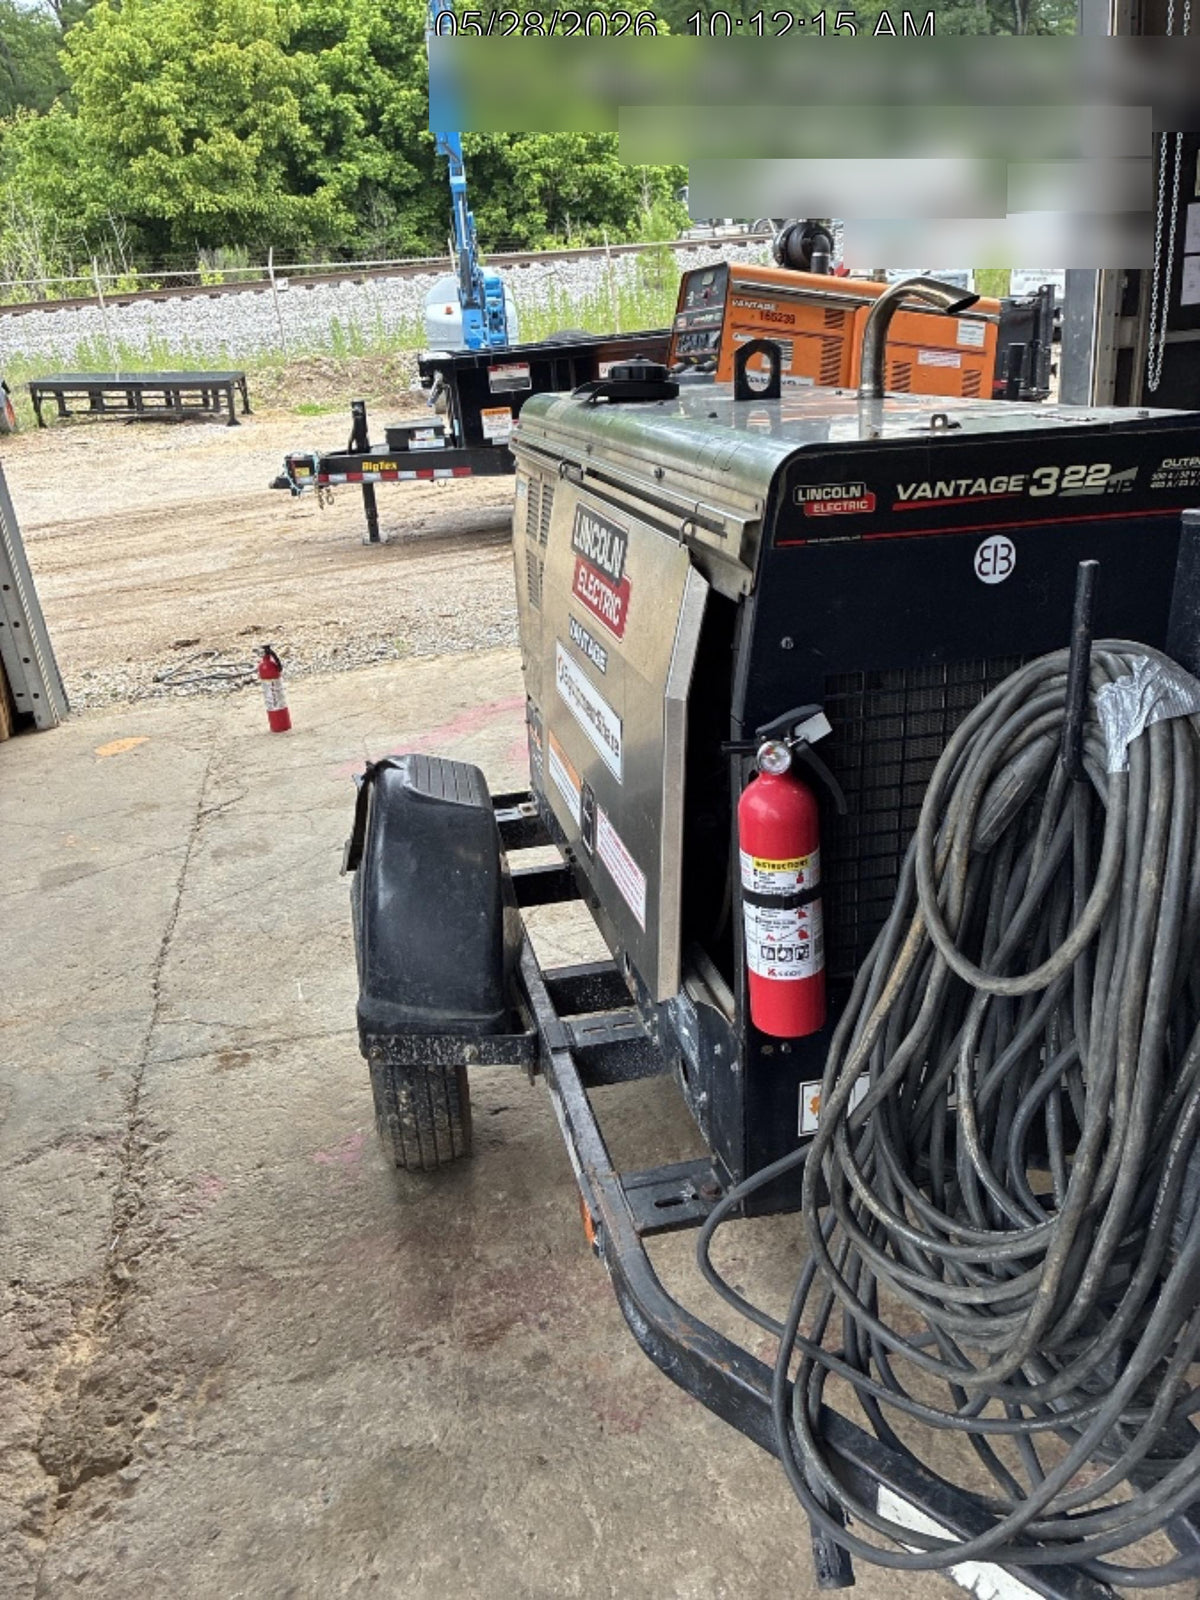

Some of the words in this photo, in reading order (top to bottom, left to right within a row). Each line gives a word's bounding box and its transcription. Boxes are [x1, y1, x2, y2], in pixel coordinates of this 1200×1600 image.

[732, 299, 777, 311] VANTAGE
[798, 485, 862, 501] LINCOLN
[896, 475, 1024, 500] VANTAGE
[1029, 463, 1112, 497] 322
[813, 500, 869, 513] ELECTRIC
[573, 511, 624, 579] LINCOLN
[577, 565, 622, 627] ELECTRIC
